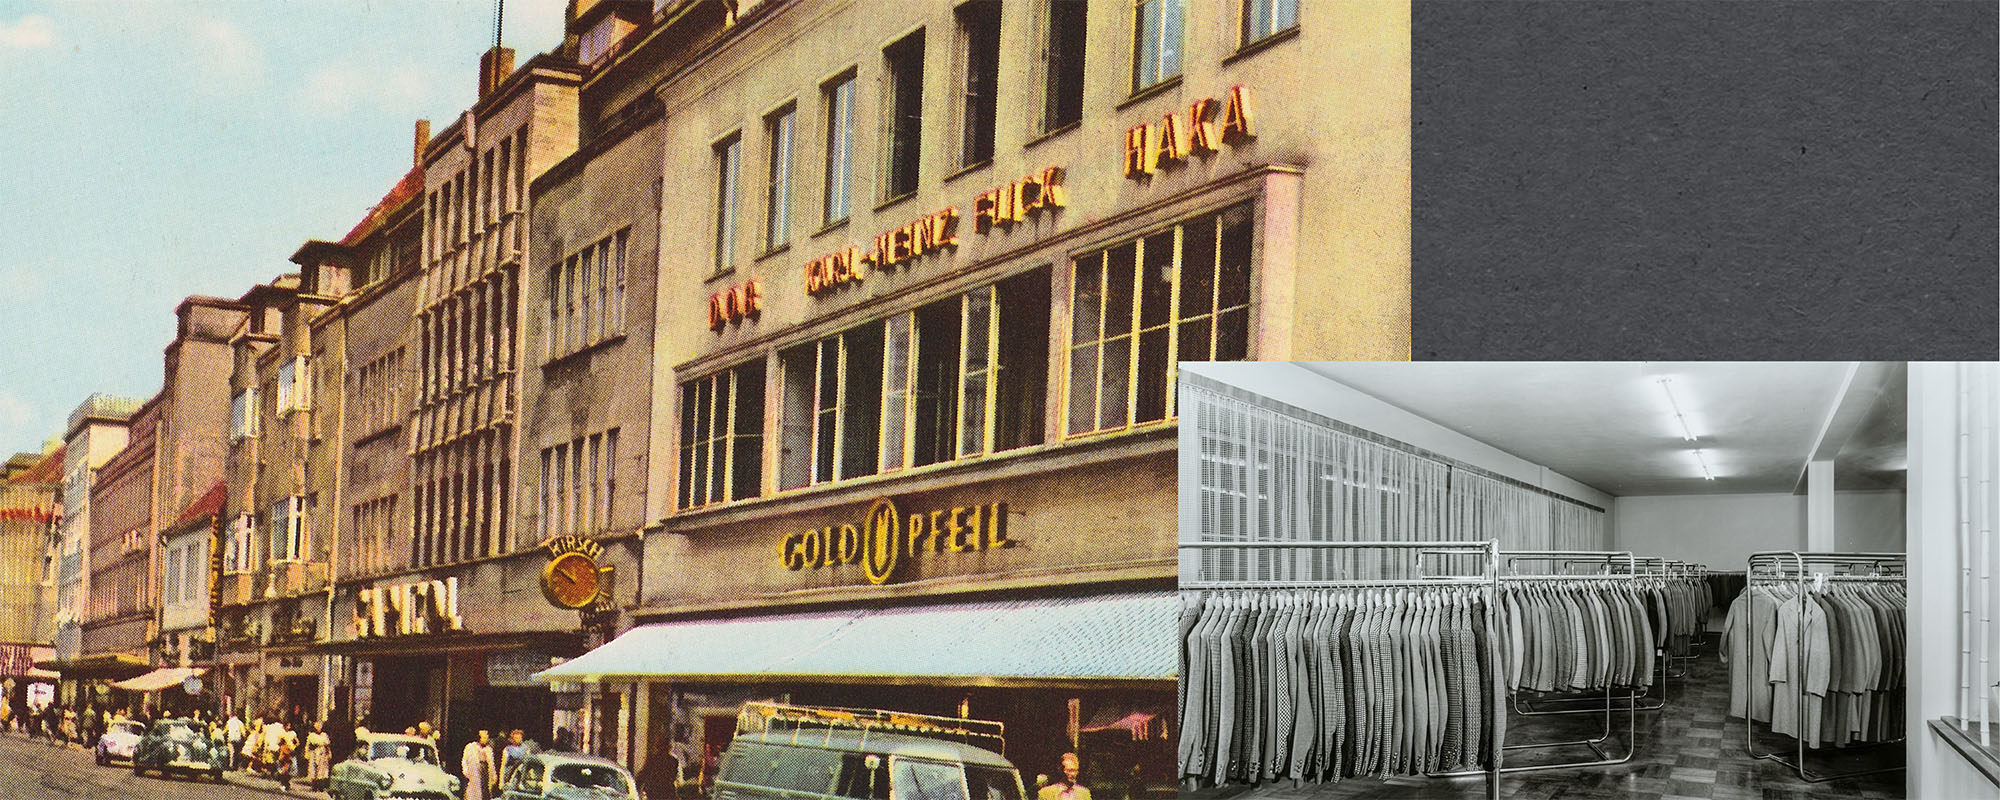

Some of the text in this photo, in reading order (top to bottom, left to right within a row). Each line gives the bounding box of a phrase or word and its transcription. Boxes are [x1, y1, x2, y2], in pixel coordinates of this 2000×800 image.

[804, 205, 959, 295] KARL-HEINZ
[1124, 83, 1256, 177] HAKA
[548, 534, 606, 560] KIRSCH
[776, 502, 1007, 569] GOLD PFEIL
